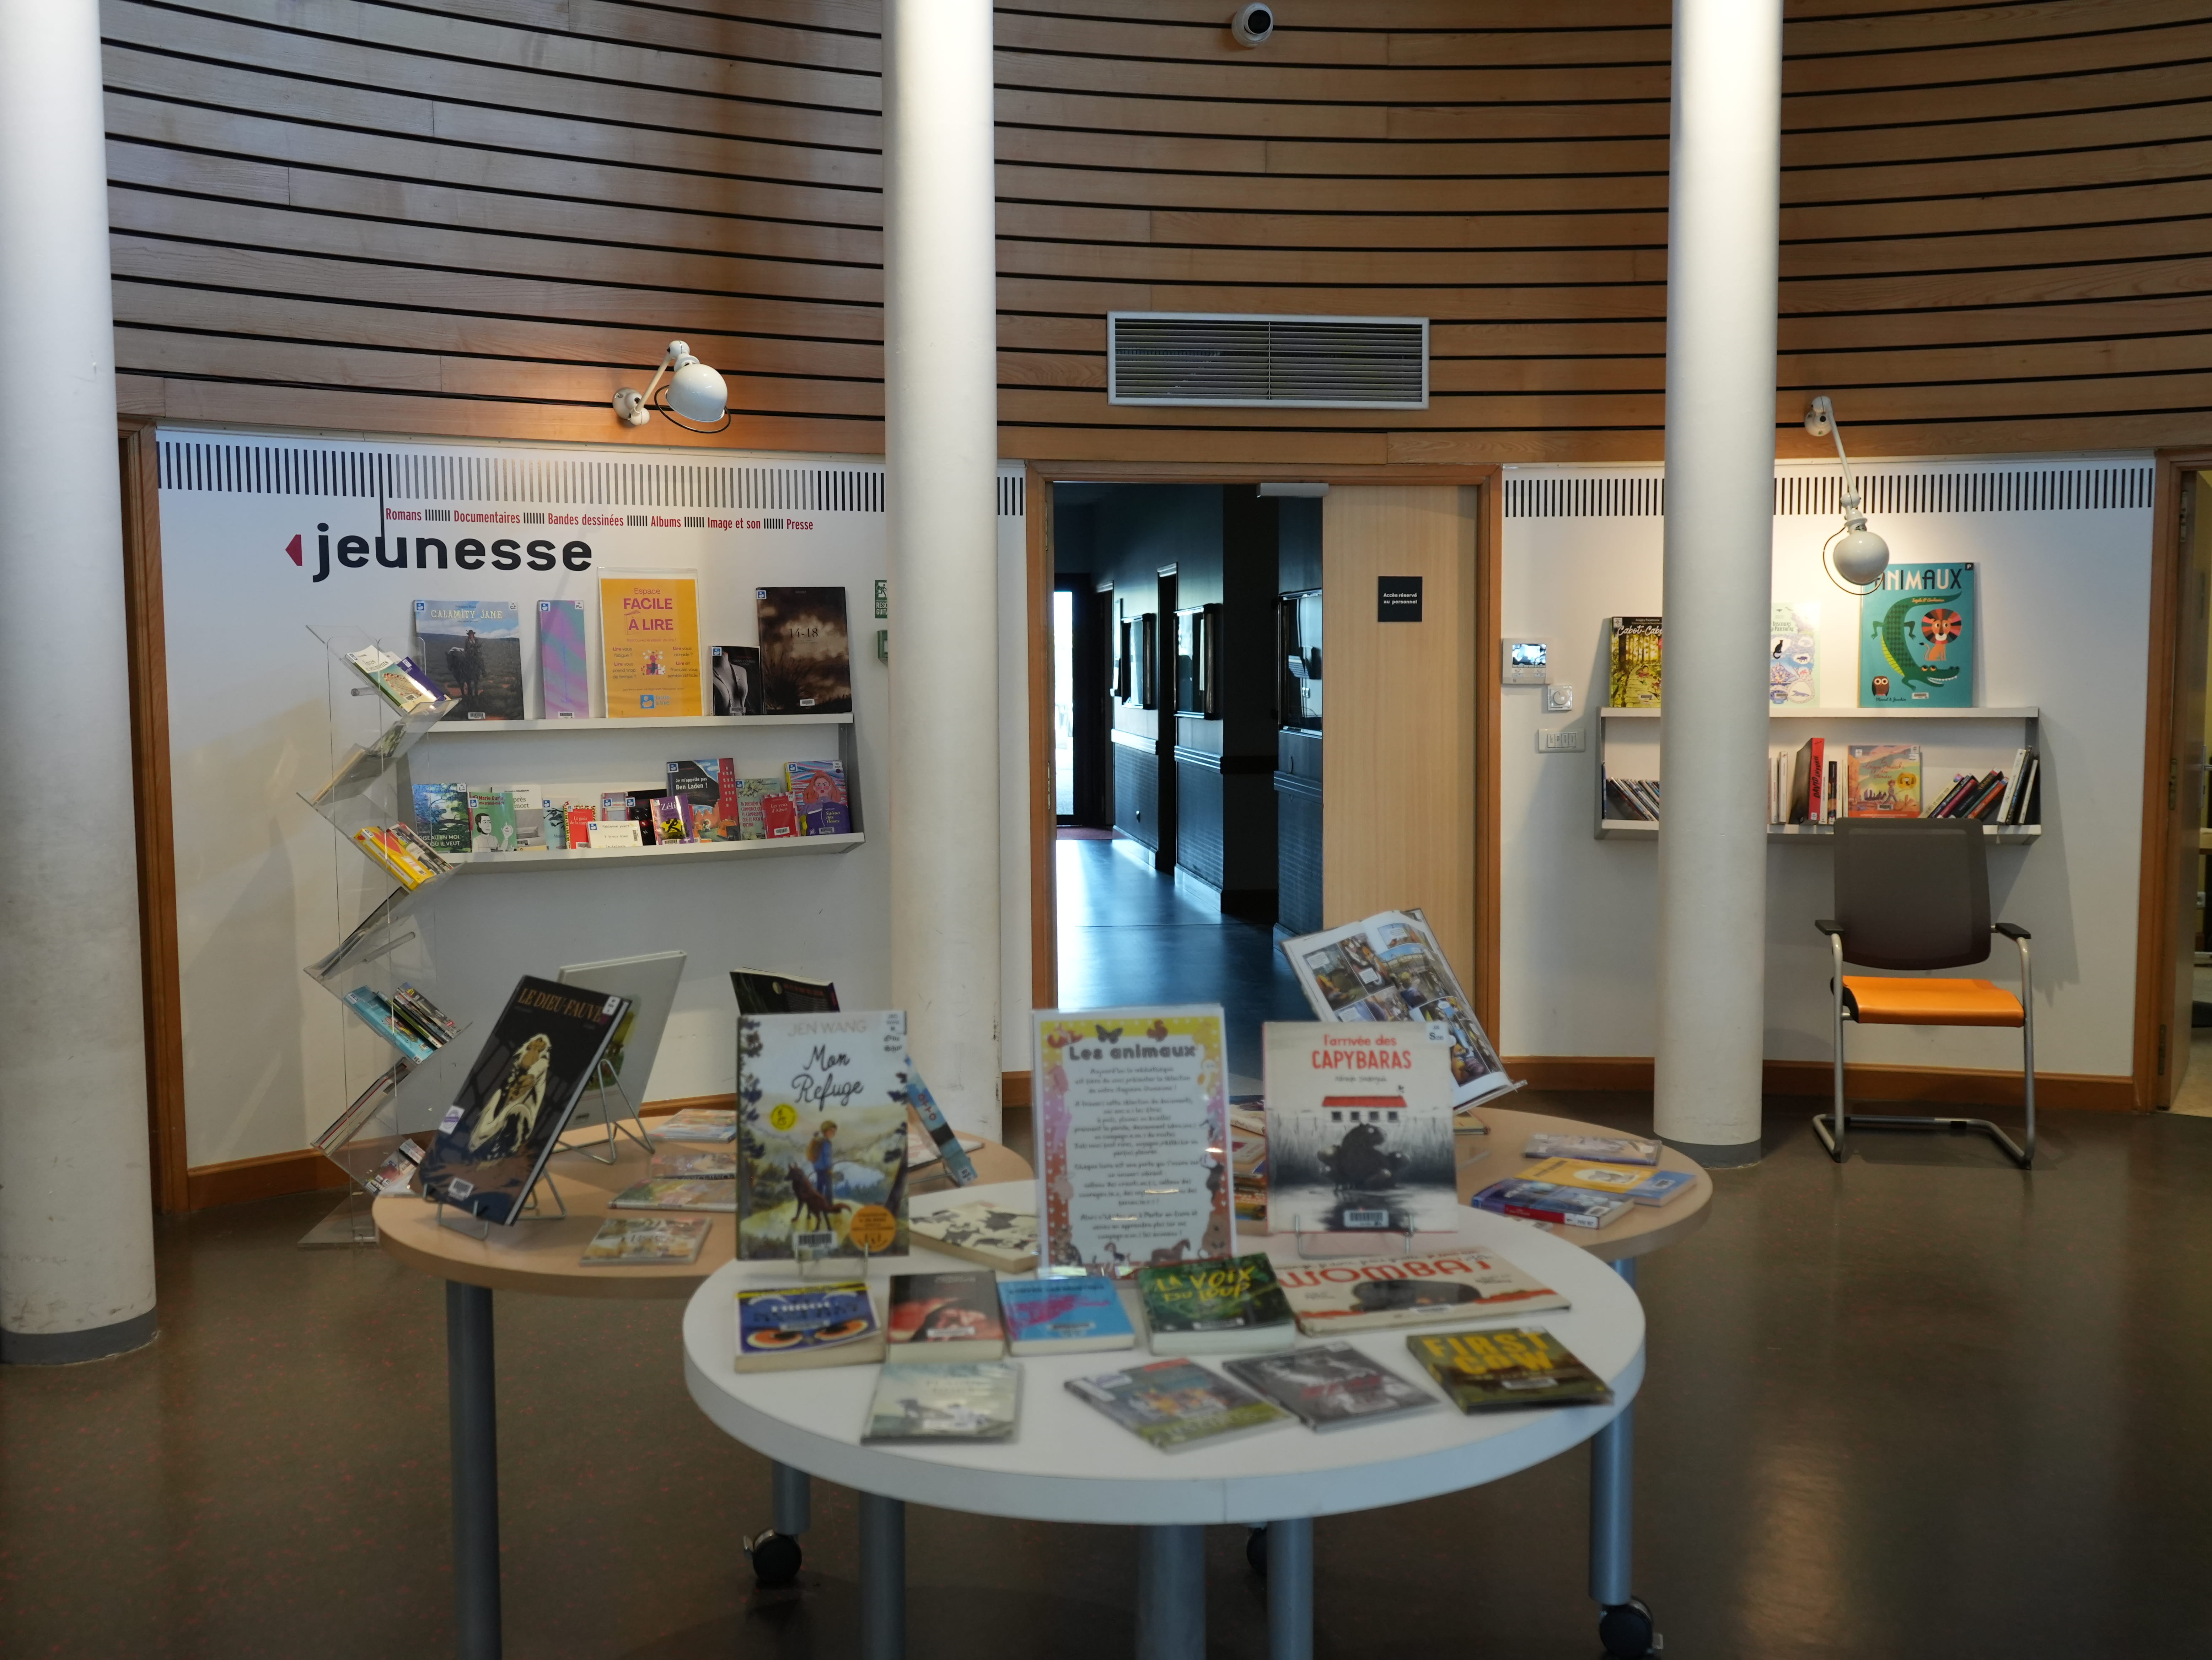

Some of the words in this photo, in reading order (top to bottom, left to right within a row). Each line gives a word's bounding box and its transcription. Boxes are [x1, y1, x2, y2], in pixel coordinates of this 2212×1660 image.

[386, 508, 422, 521] Romans
[454, 510, 520, 523] Documentaires
[548, 513, 579, 525] Bandes
[582, 514, 624, 526] dessinées
[651, 516, 681, 527] Albums
[707, 517, 732, 530] Image
[736, 518, 743, 528] et
[747, 520, 761, 529] son
[787, 518, 813, 530] Presse
[313, 523, 591, 582] jeunesse
[624, 598, 673, 609] FACILE
[629, 617, 639, 630] À
[643, 619, 673, 630] LIRE
[790, 628, 818, 638] 14-18
[660, 802, 679, 810] Zéli
[518, 988, 537, 1005] LE
[788, 1021, 816, 1036] JEN
[820, 1019, 867, 1033] WANG
[1324, 1034, 1371, 1046] l'arrivée
[1375, 1034, 1397, 1046] des
[803, 1044, 850, 1071] Mon
[1069, 1046, 1103, 1060] Les
[1110, 1044, 1196, 1060] animaux
[1312, 1050, 1412, 1069] CAPYBARAS
[791, 1073, 864, 1111] Refuge
[1156, 1274, 1182, 1292] LA
[1190, 1266, 1255, 1290] VOIX
[1199, 1282, 1251, 1301] LOUP
[1421, 1332, 1549, 1357] FIRST
[1454, 1351, 1554, 1375] COW
